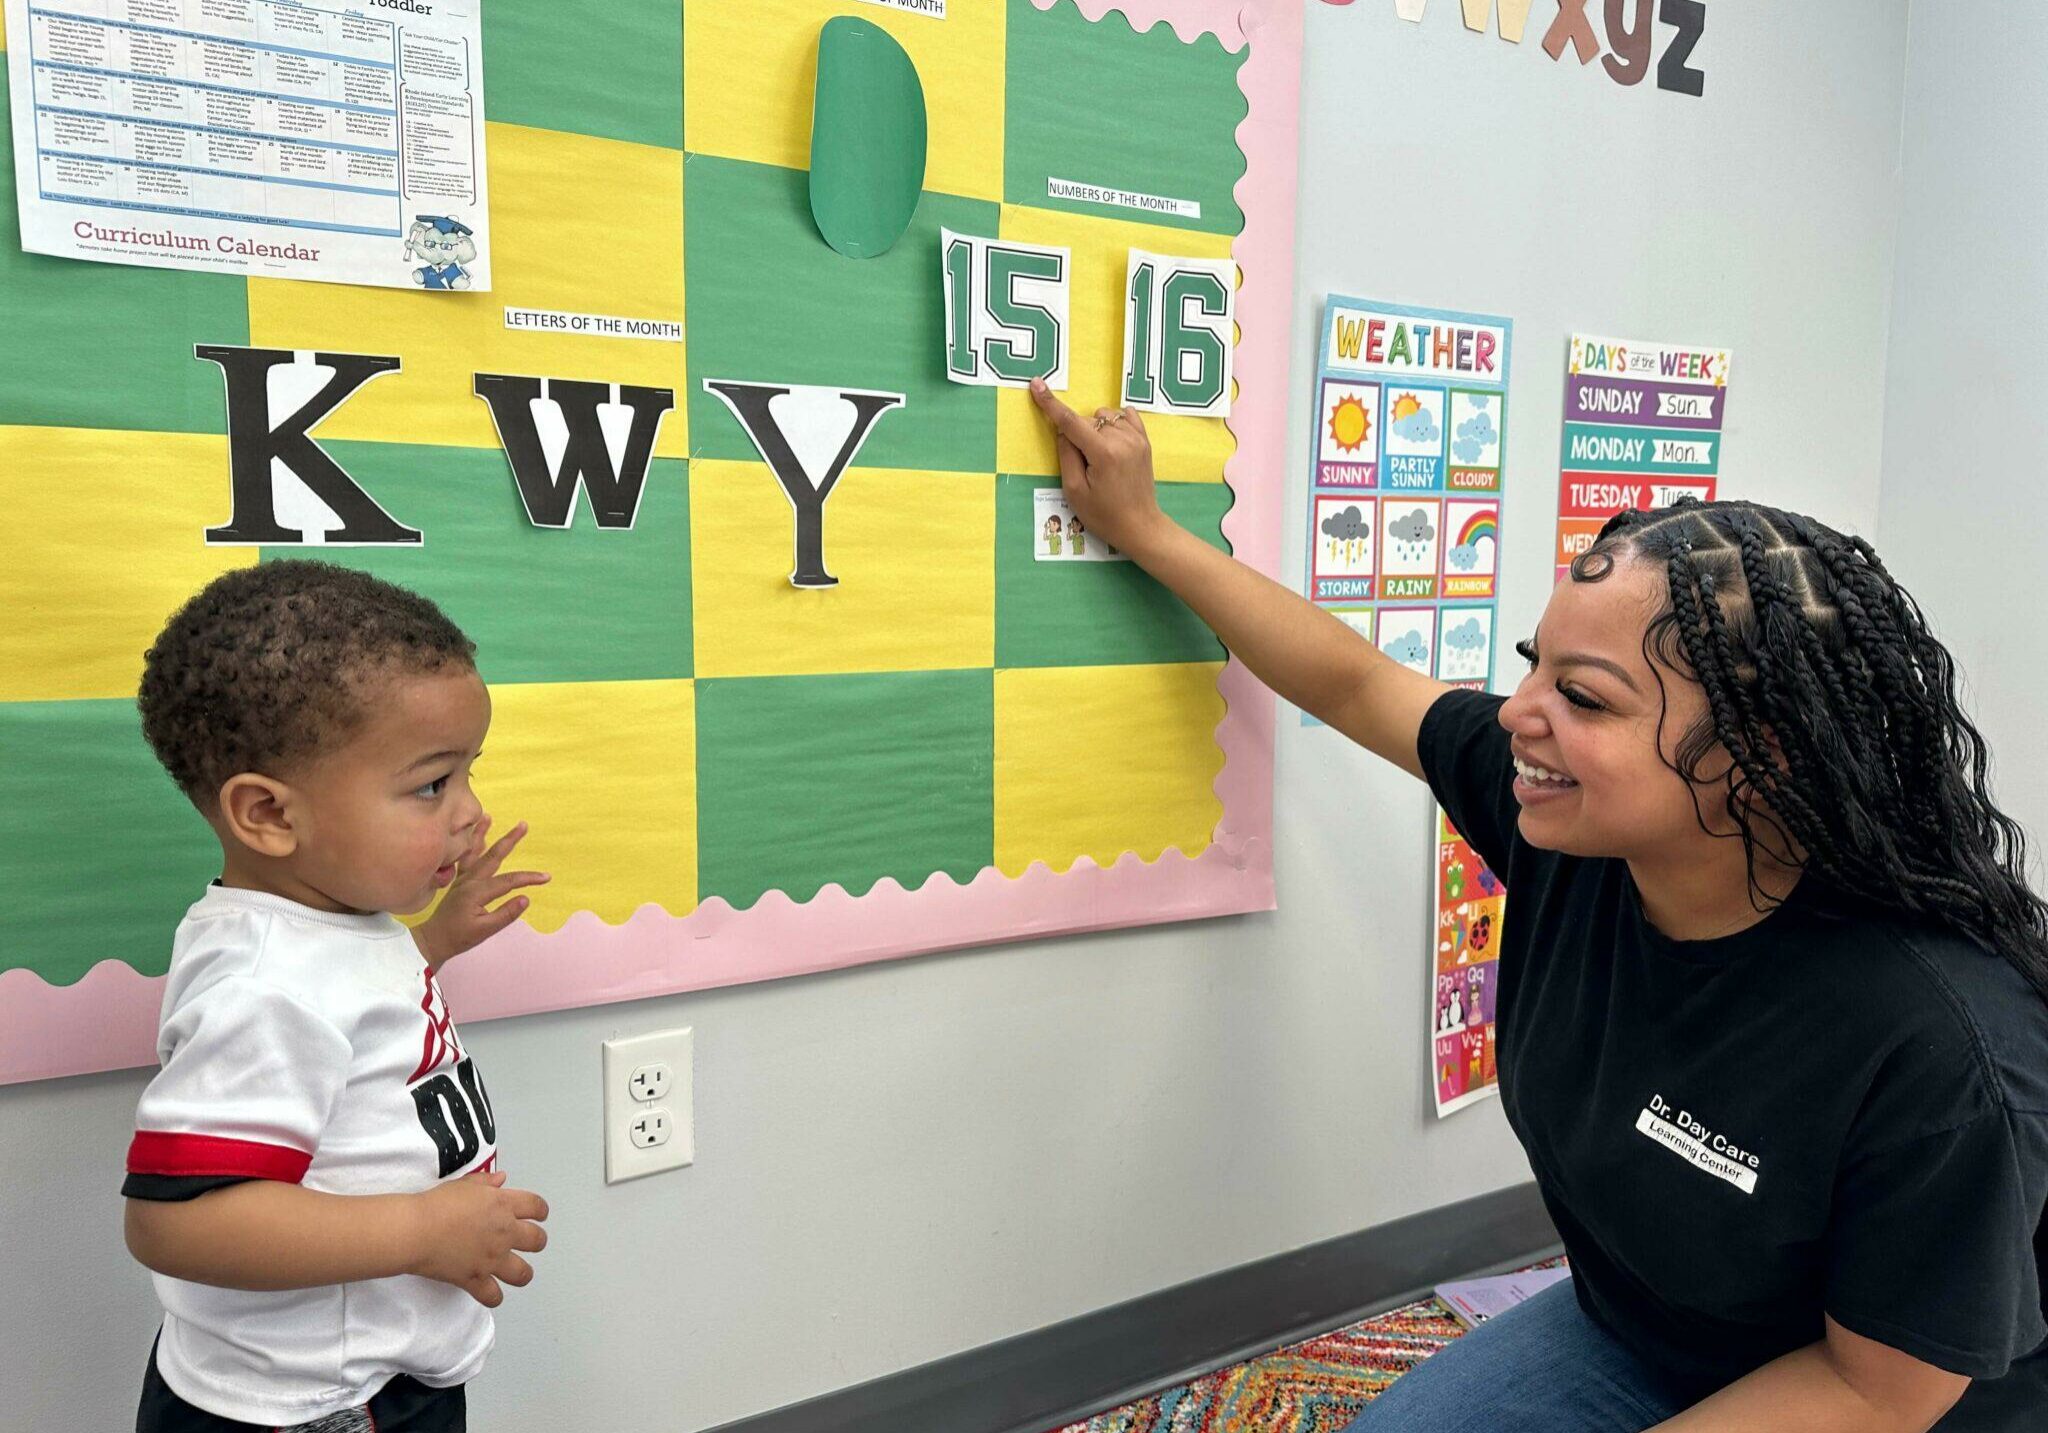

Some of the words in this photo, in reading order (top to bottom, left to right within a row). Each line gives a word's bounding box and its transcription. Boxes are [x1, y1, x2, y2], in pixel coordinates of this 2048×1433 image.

[1049, 182, 1100, 201] NUMBERS
[1103, 191, 1116, 203] OF
[1119, 193, 1137, 206] THE
[1140, 196, 1177, 212] MONTH
[74, 221, 210, 251] Curriculum
[217, 236, 320, 262] Calendar
[506, 311, 567, 329] LETTERS
[571, 316, 590, 331] OF
[594, 317, 622, 333] THE
[627, 320, 681, 337] MONTH
[947, 238, 1062, 382] 15
[1125, 263, 1228, 408] 16
[1337, 315, 1496, 373] WEATHER
[1584, 342, 1627, 372] DAYS
[1631, 355, 1641, 368] of
[1642, 356, 1655, 369] the
[1660, 351, 1714, 379] WEEK
[1578, 386, 1643, 415] SUNDAY
[1666, 395, 1702, 416] Sun.
[1570, 435, 1645, 462] MONDAY
[1662, 442, 1698, 463] Mon.
[196, 345, 422, 543] K
[475, 373, 674, 528] W
[708, 382, 900, 585] Y
[1322, 465, 1372, 485] SUNNY
[1391, 457, 1436, 473] PARTLY
[1453, 471, 1494, 487] CLOUDY
[1391, 471, 1435, 488] SUNNY
[1570, 483, 1642, 508] TUESDAY
[1319, 581, 1370, 597] STORMY
[1387, 579, 1432, 596] RAINY
[1448, 581, 1489, 593] RAINBOW
[1439, 975, 1453, 992] Pp
[1467, 967, 1485, 984] Qq
[1649, 1093, 1671, 1119] Dr.
[1676, 1110, 1711, 1143] Day
[1712, 1134, 1760, 1168] Care
[1649, 1121, 1698, 1159] Learning
[1700, 1152, 1742, 1179] Center
